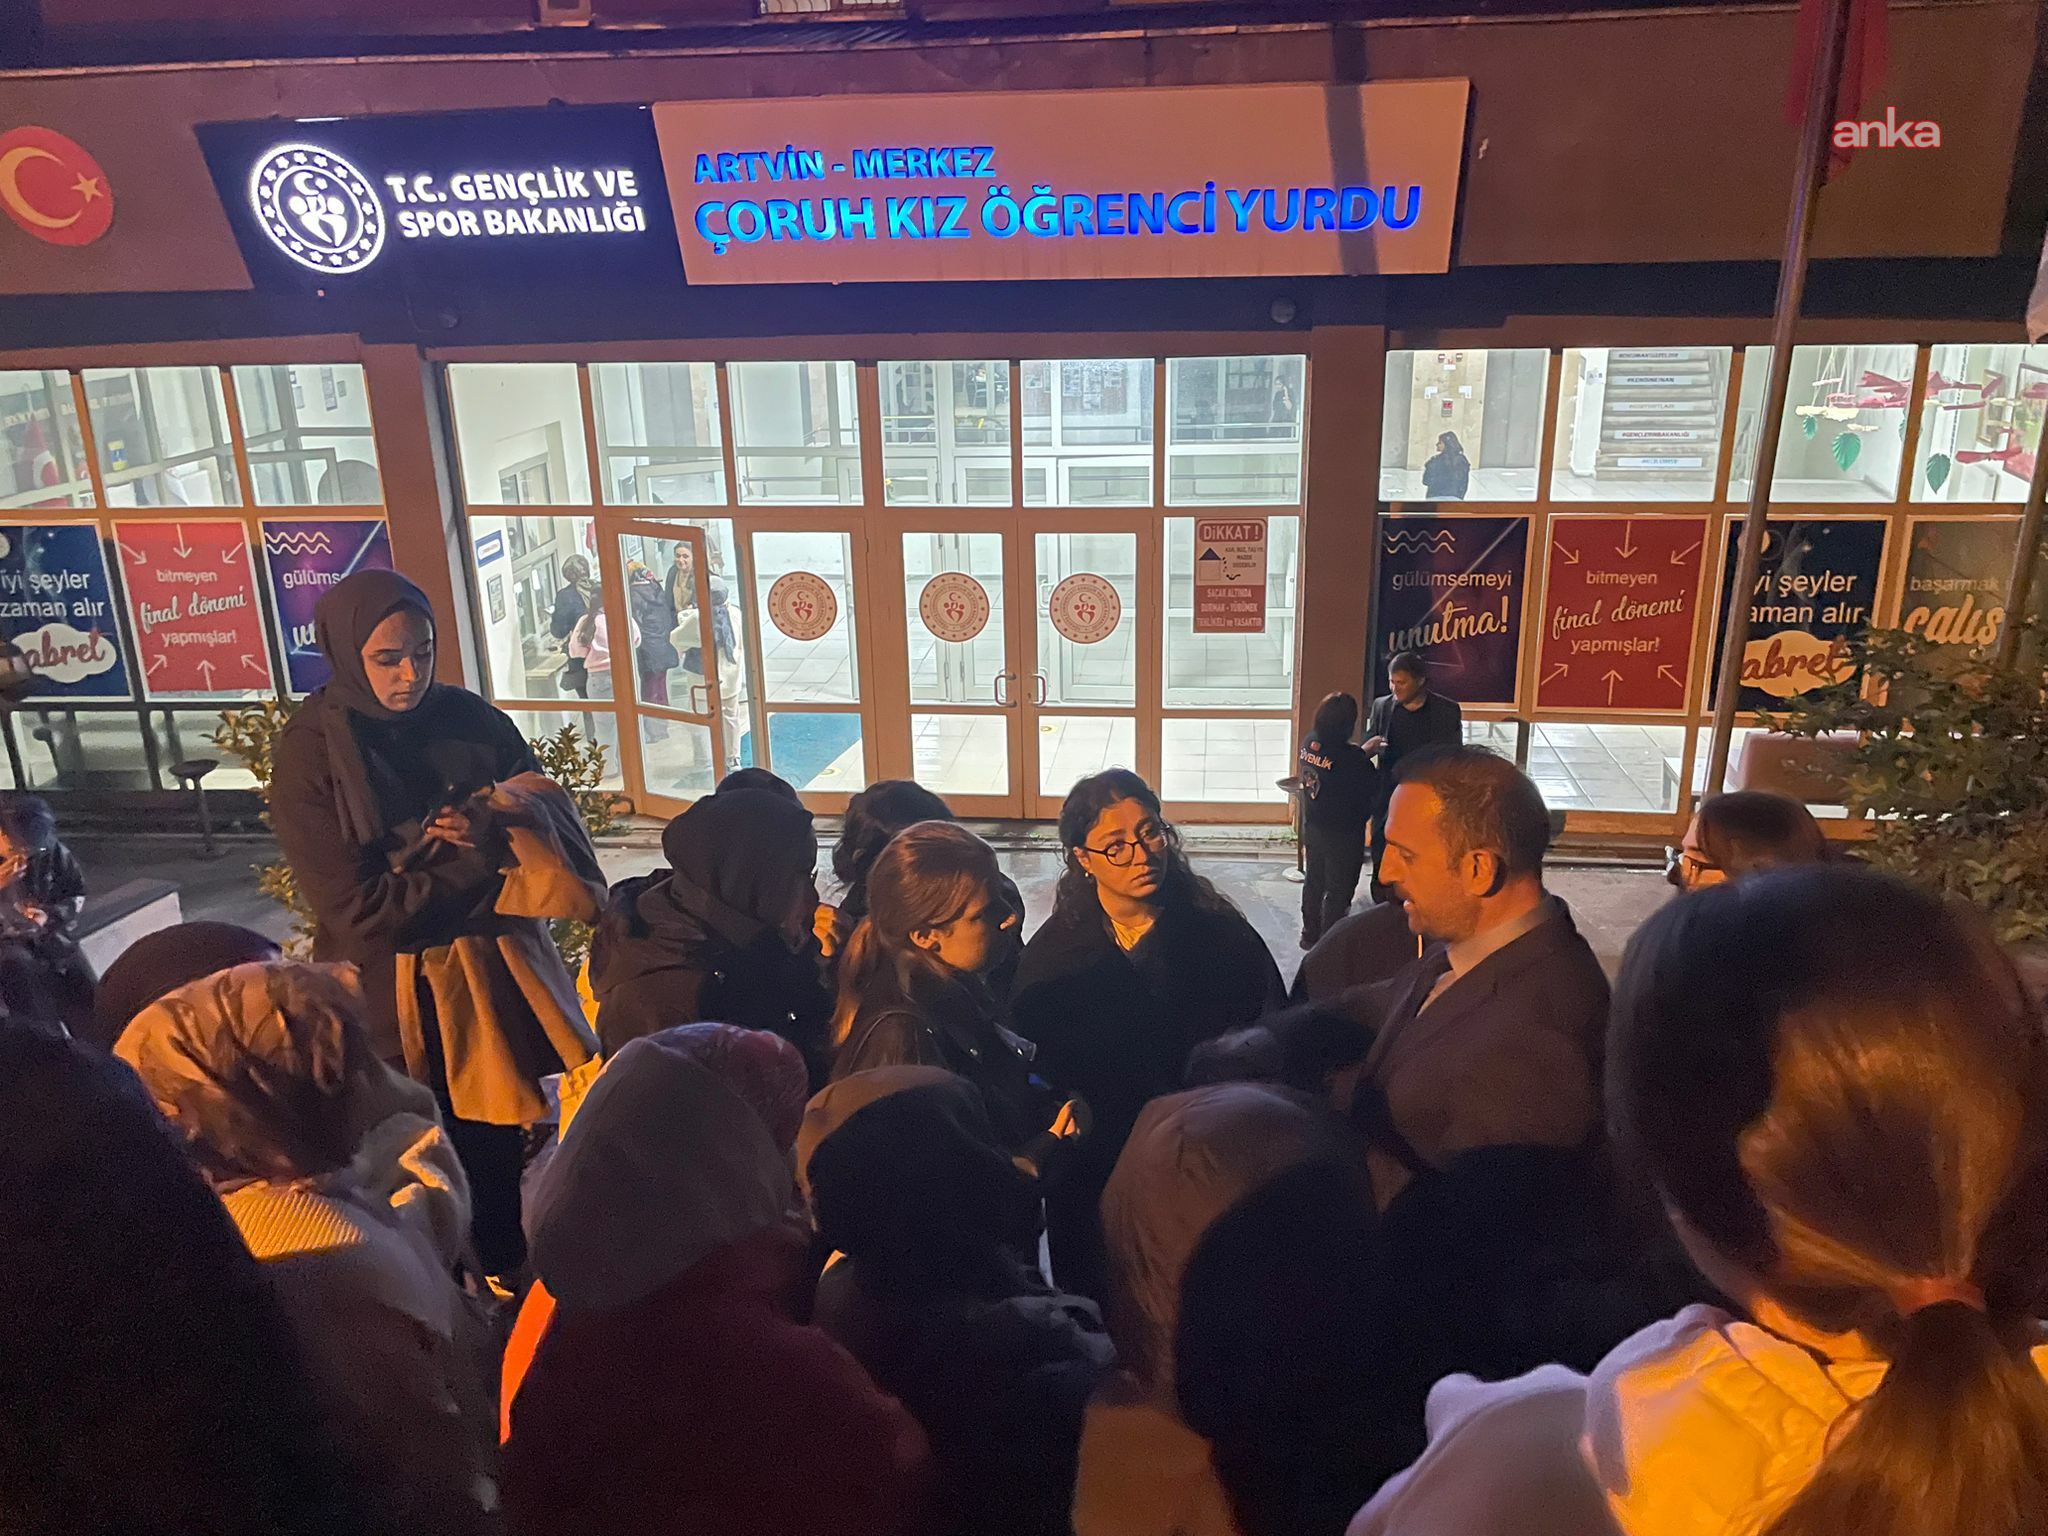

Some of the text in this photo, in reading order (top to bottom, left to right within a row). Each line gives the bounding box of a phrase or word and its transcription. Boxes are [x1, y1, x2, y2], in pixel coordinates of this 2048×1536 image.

[694, 144, 825, 183] ARTVİN
[853, 146, 996, 180] MERKEZ
[384, 166, 638, 206] T.C. GENÇLİK VE
[398, 200, 646, 239] SPOR BAKANLIĞI
[694, 180, 1422, 256] ÇORUH KIZ ÖĞRENCİ YURDU
[1203, 525, 1251, 541] DİKKAT
[29, 568, 91, 595] şeyler
[156, 569, 218, 586] bitmeyen
[283, 569, 346, 589] gülüms
[1392, 569, 1513, 591] gülümsemeyi
[1585, 570, 1658, 586] bitmeyen
[1753, 569, 1858, 598] yi şeyler
[1910, 576, 2001, 595] başarmak
[0, 597, 105, 617] zaman alır
[141, 586, 248, 634] final dönemi
[1551, 589, 1686, 640] final dönemi
[1749, 601, 1866, 624] aman alır
[1388, 595, 1509, 652] unutma!
[24, 627, 112, 668] abret
[161, 629, 238, 648] yapmışlar!
[1571, 636, 1660, 656] yapmışlar!
[1741, 634, 1853, 681] abret
[1300, 747, 1333, 770] ÜVENLİK
